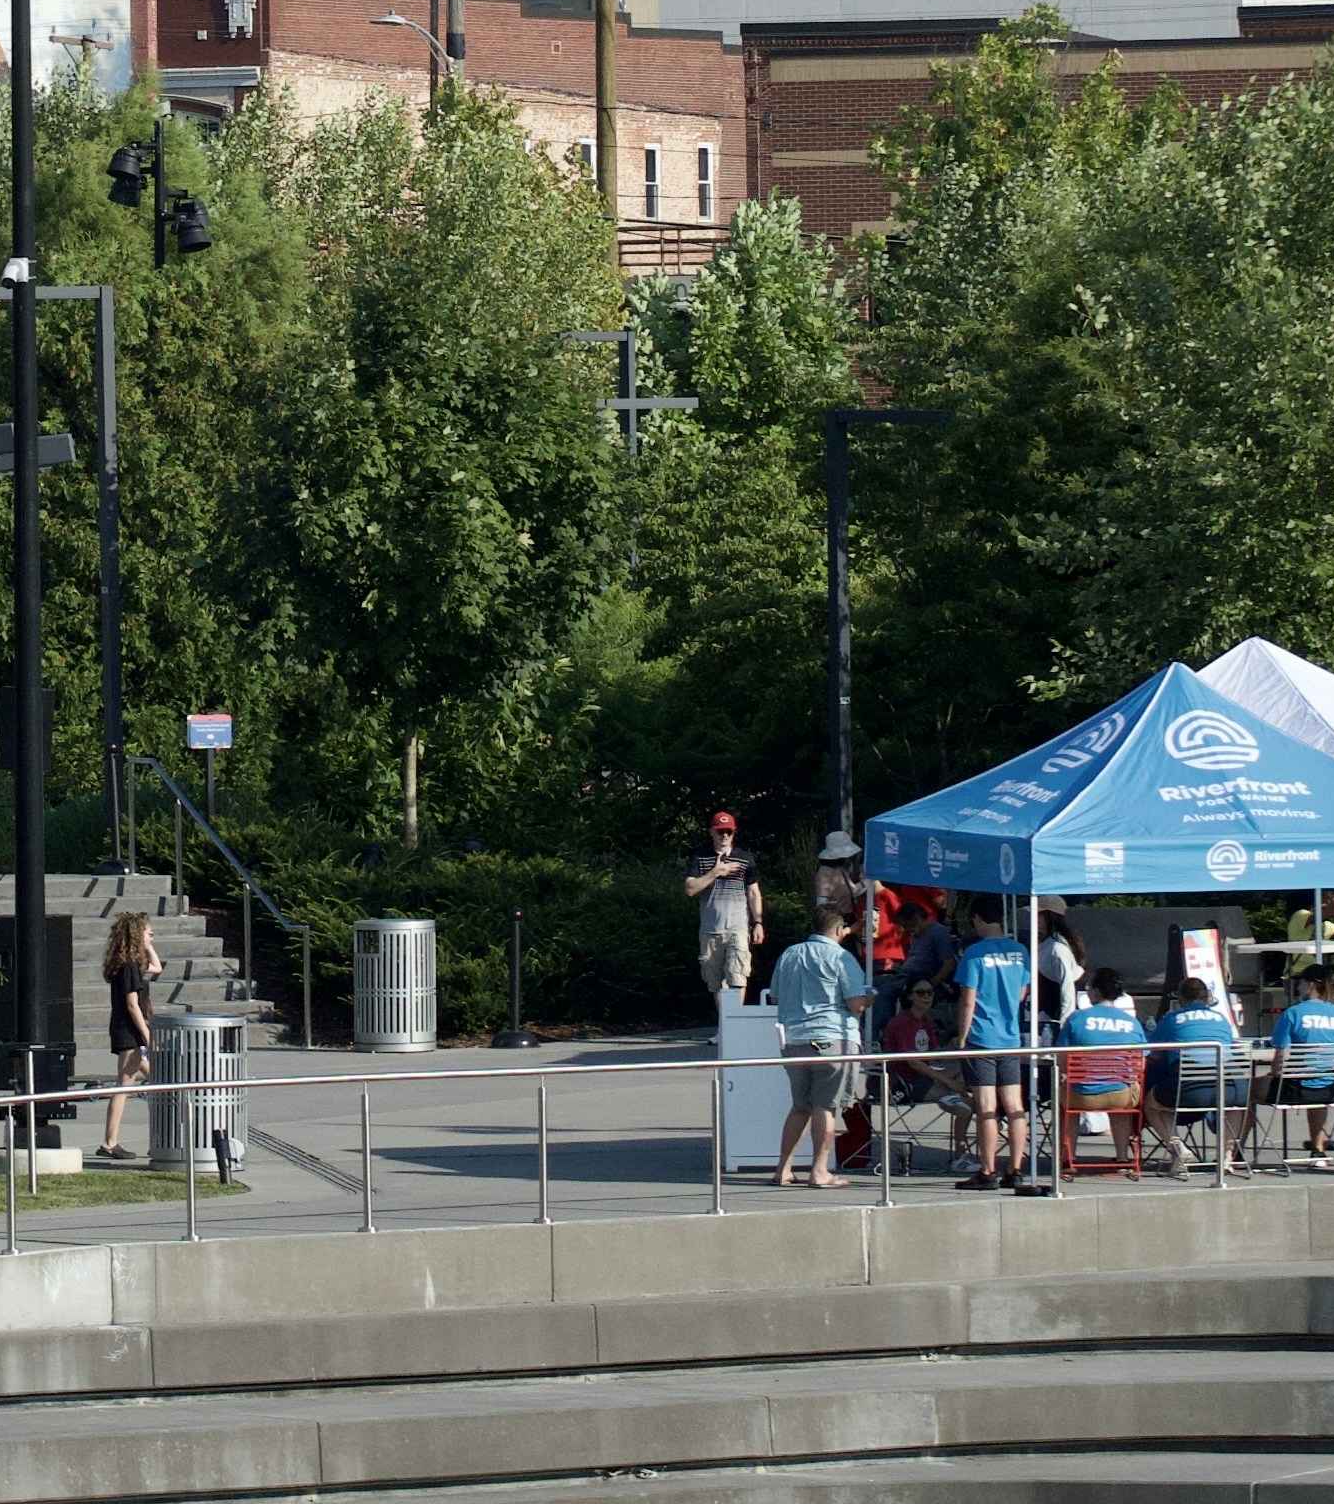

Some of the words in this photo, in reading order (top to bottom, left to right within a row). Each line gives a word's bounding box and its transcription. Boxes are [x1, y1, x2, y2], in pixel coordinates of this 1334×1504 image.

[1157, 776, 1312, 802] Riverfront
[1197, 796, 1234, 808] FORT
[1237, 793, 1288, 803] WAYNE
[1182, 810, 1246, 823] Always
[1249, 808, 1322, 820] moving.
[1254, 849, 1320, 862] Riverfront
[983, 951, 1024, 968] STAFF
[1175, 1008, 1223, 1024] STAFF
[1085, 1016, 1134, 1033] STAFF
